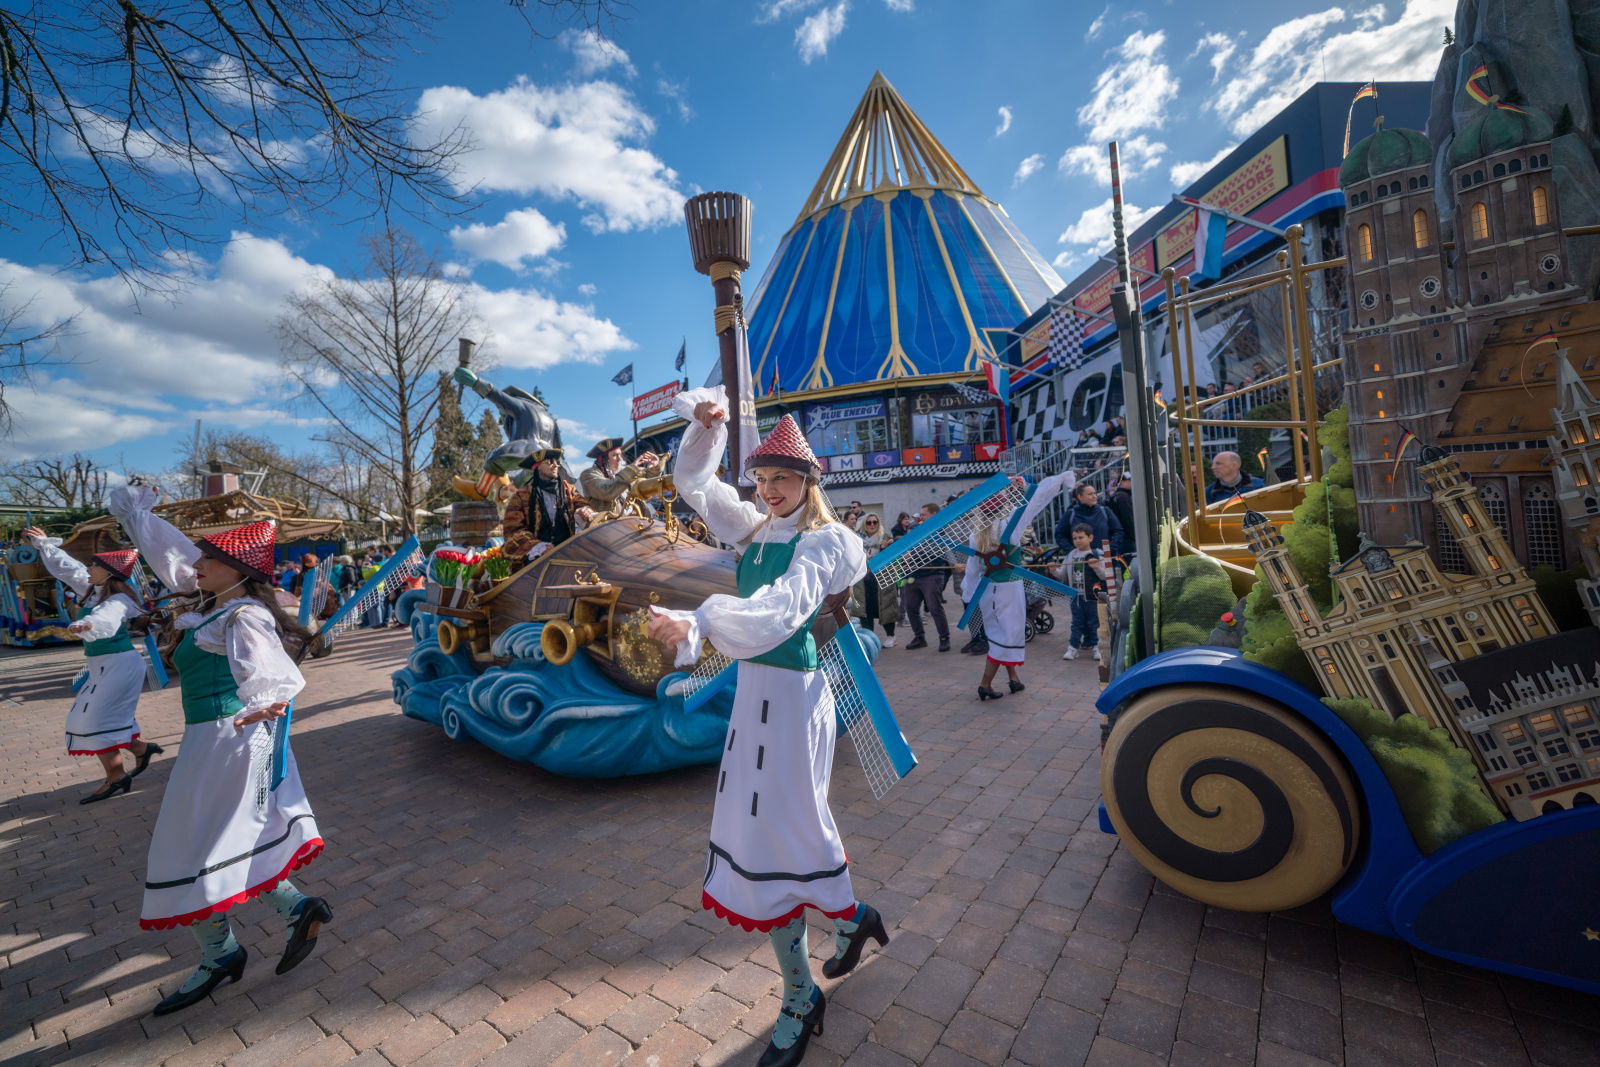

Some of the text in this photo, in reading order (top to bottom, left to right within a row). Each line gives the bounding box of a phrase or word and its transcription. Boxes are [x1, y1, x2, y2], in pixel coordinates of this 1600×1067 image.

[1219, 164, 1274, 207] MOTORS
[821, 406, 881, 420] BLUE ENERGY
[873, 470, 890, 478] GP
